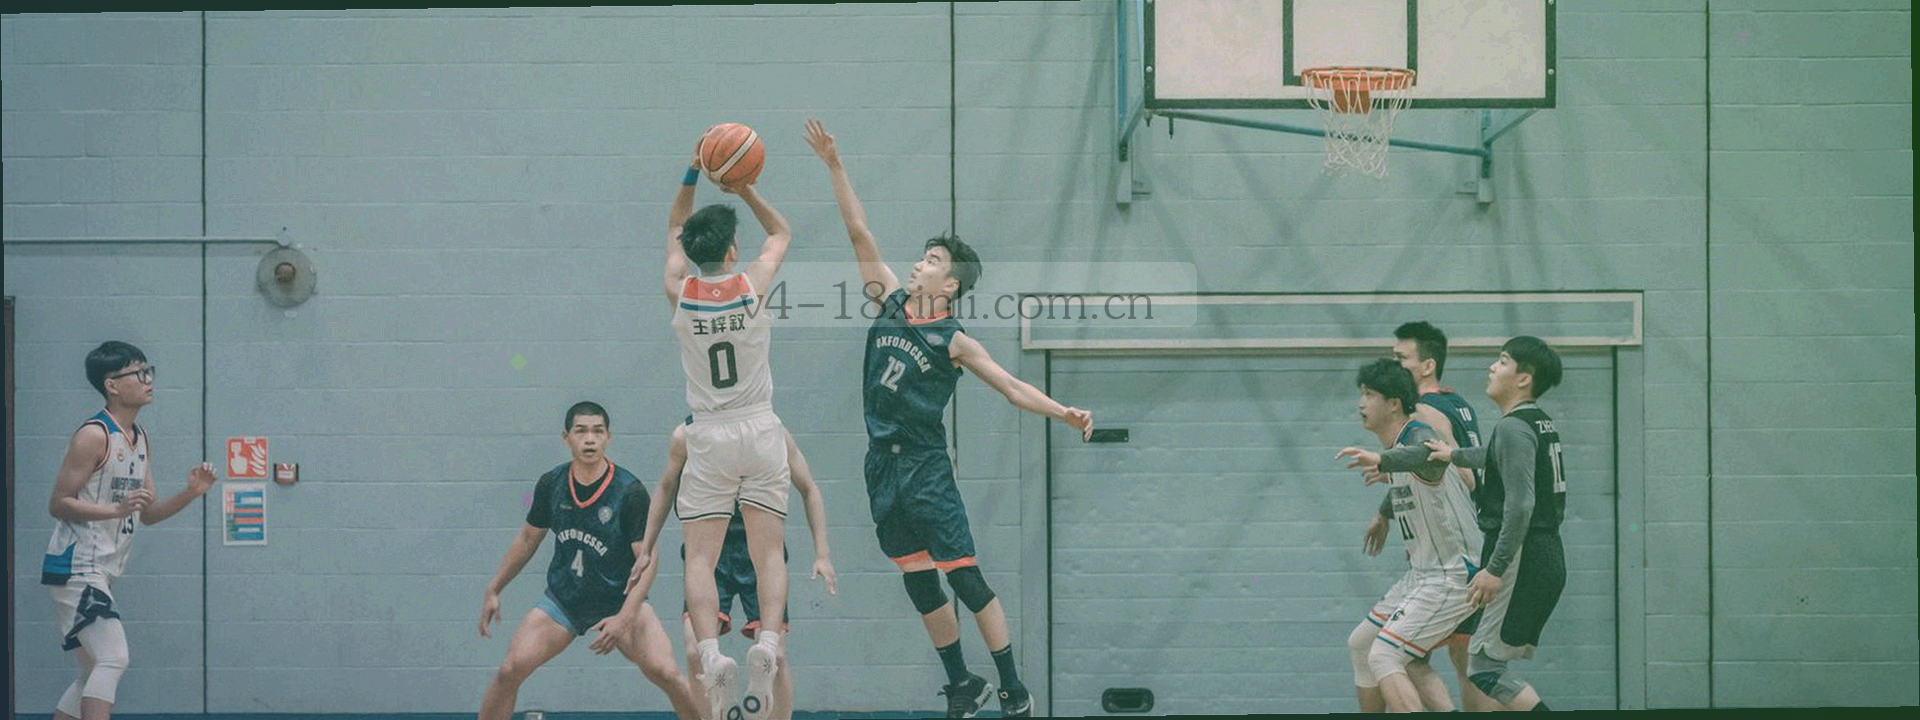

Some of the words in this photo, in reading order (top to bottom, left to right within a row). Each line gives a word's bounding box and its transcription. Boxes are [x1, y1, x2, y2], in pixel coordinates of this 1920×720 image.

[708, 341, 738, 389] 0
[876, 335, 931, 373] OXFORDCSSA
[880, 355, 906, 392] 12
[571, 549, 584, 577] 4
